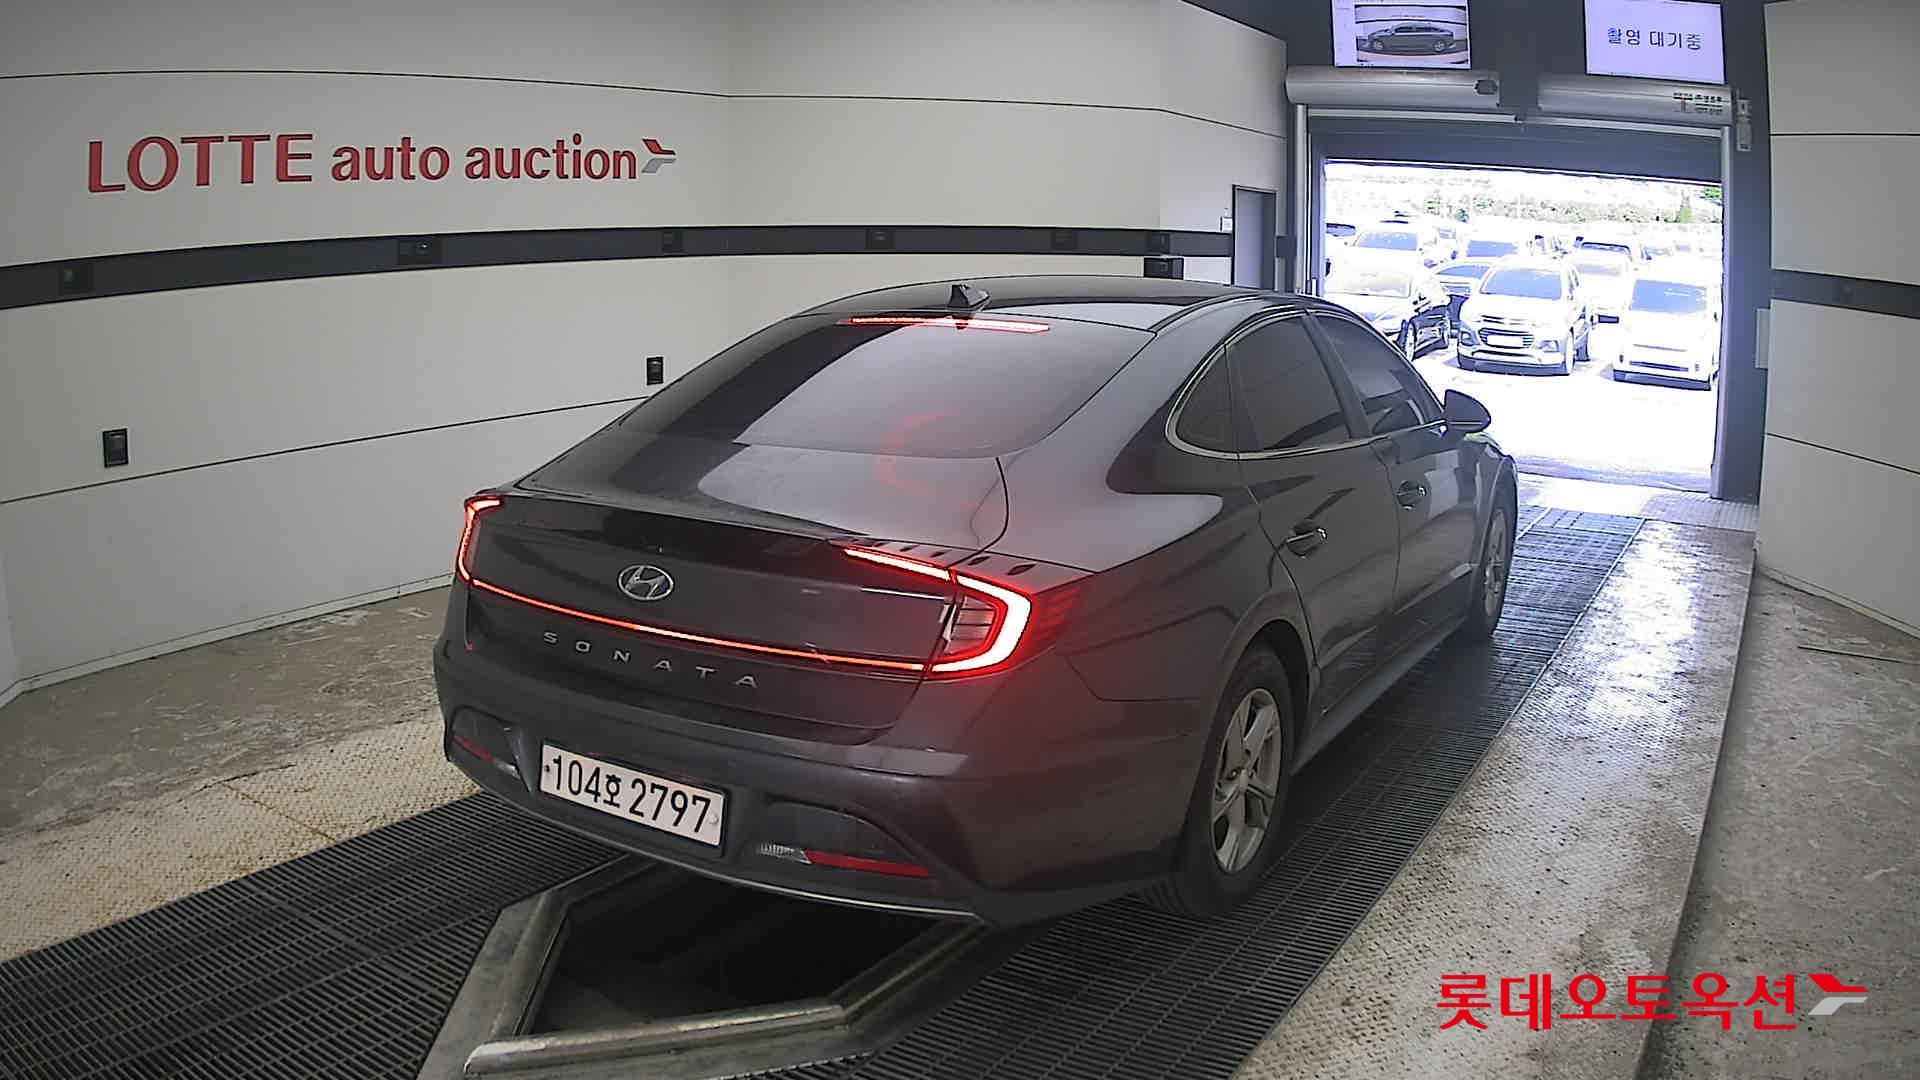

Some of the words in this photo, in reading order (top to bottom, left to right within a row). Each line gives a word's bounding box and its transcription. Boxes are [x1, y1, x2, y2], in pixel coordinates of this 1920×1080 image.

[1649, 30, 1701, 51] 대기중
[88, 133, 312, 193] LOTTE
[331, 136, 450, 181] auto
[464, 133, 638, 180] auction
[543, 631, 758, 689] SONATA
[552, 755, 622, 809] 104호
[629, 778, 712, 833] 2797
